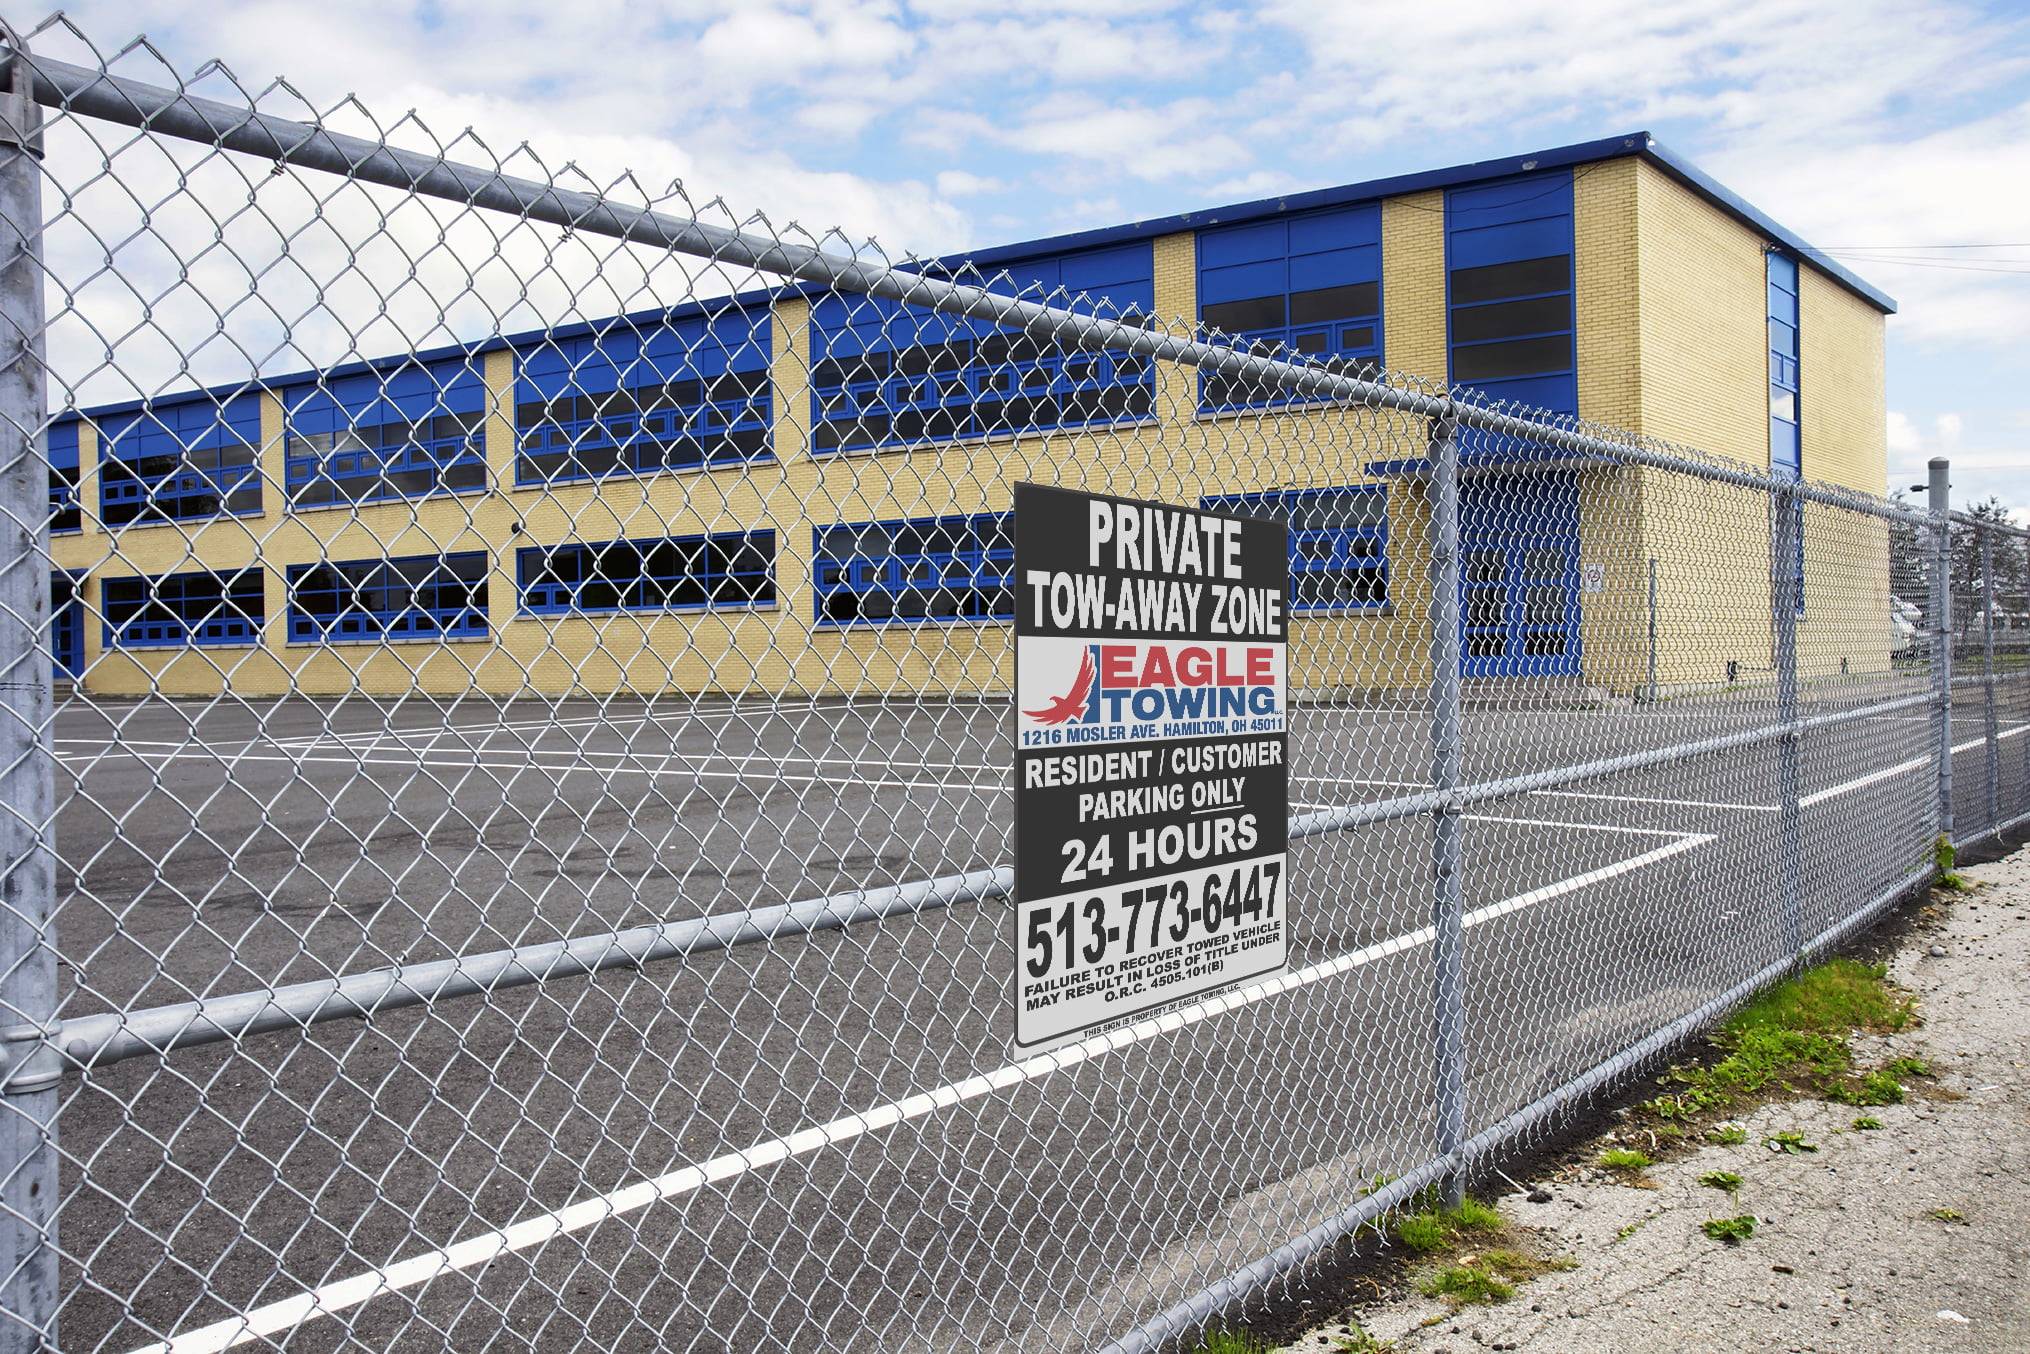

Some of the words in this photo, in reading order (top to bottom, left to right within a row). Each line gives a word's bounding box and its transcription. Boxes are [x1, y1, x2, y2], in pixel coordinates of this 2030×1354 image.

[1089, 499, 1242, 580] PRIVATE
[1027, 569, 1203, 633] TOW-AWAY
[1210, 585, 1281, 636] ZONE
[1101, 645, 1275, 688] EAGLE
[1101, 686, 1275, 723] TOWING
[1023, 730, 1062, 746] 1216
[1066, 725, 1126, 743] MOSLER
[1130, 723, 1160, 741] AVE.
[1163, 719, 1229, 738] HAMILTON,
[1231, 719, 1247, 734] OH
[1250, 717, 1283, 731] 45011
[1025, 750, 1153, 789] RESIDENT
[1158, 749, 1165, 776] /
[1171, 740, 1282, 775] CUSTOMER
[1079, 783, 1184, 823] PARKING
[1191, 776, 1246, 808] ONLY
[1060, 834, 1113, 884] 24
[1128, 813, 1258, 871] HOURS
[1026, 861, 1281, 978] 513-773-6447
[1024, 969, 1091, 997] FAILURE
[1095, 964, 1115, 977] TO
[1119, 946, 1183, 971] RECOVER
[1187, 934, 1229, 953] TOWED
[1233, 920, 1281, 940] VEHICLE
[1026, 992, 1060, 1011] MAY
[1065, 975, 1124, 1000] RESULT
[1127, 969, 1143, 983] IN
[1146, 959, 1181, 978] LOSS
[1184, 954, 1201, 968] OF
[1205, 943, 1239, 961] TITLE
[1241, 932, 1280, 950] UNDER
[1104, 982, 1147, 1002] O.R.C.
[1150, 960, 1224, 989] 4505.101(B)
[1083, 1027, 1102, 1038] THIS
[1103, 1020, 1121, 1032] SIGN
[1122, 1017, 1130, 1026] IS
[1131, 1005, 1167, 1023] PROPERTY
[1168, 1002, 1177, 1011] OF
[1178, 995, 1199, 1009] EAGLE
